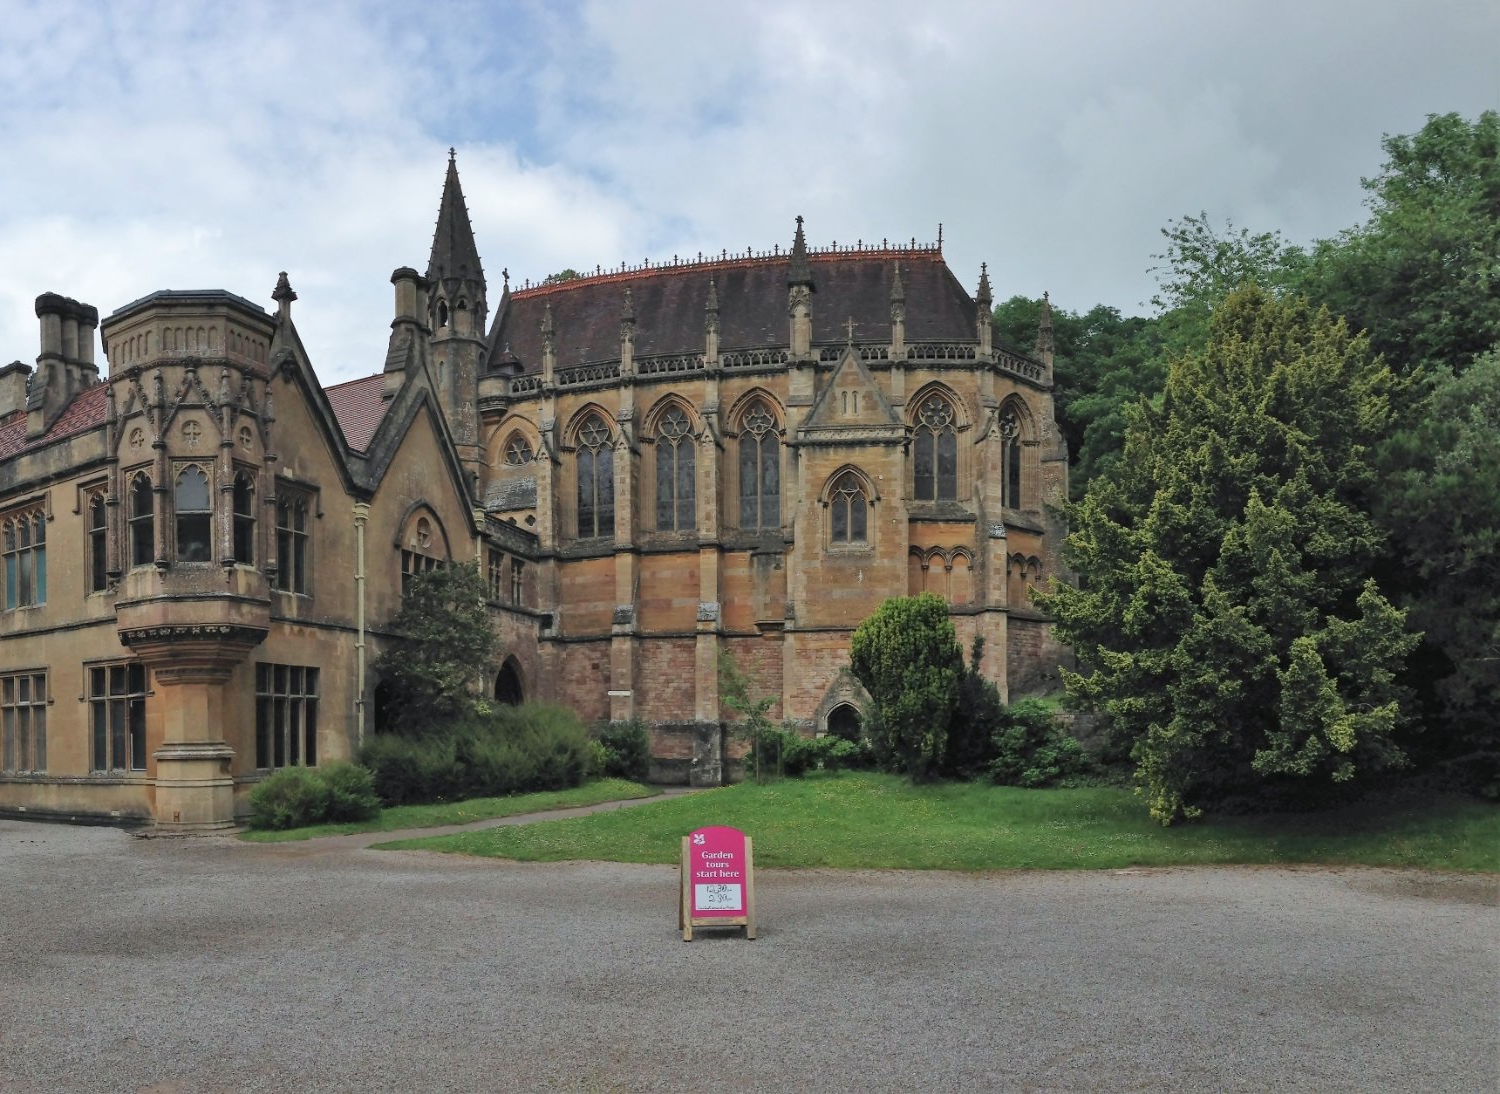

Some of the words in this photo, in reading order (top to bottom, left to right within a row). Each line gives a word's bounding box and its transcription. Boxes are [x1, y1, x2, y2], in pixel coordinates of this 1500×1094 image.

[701, 851, 733, 859] Garden
[696, 870, 717, 878] start
[719, 870, 739, 878] here
